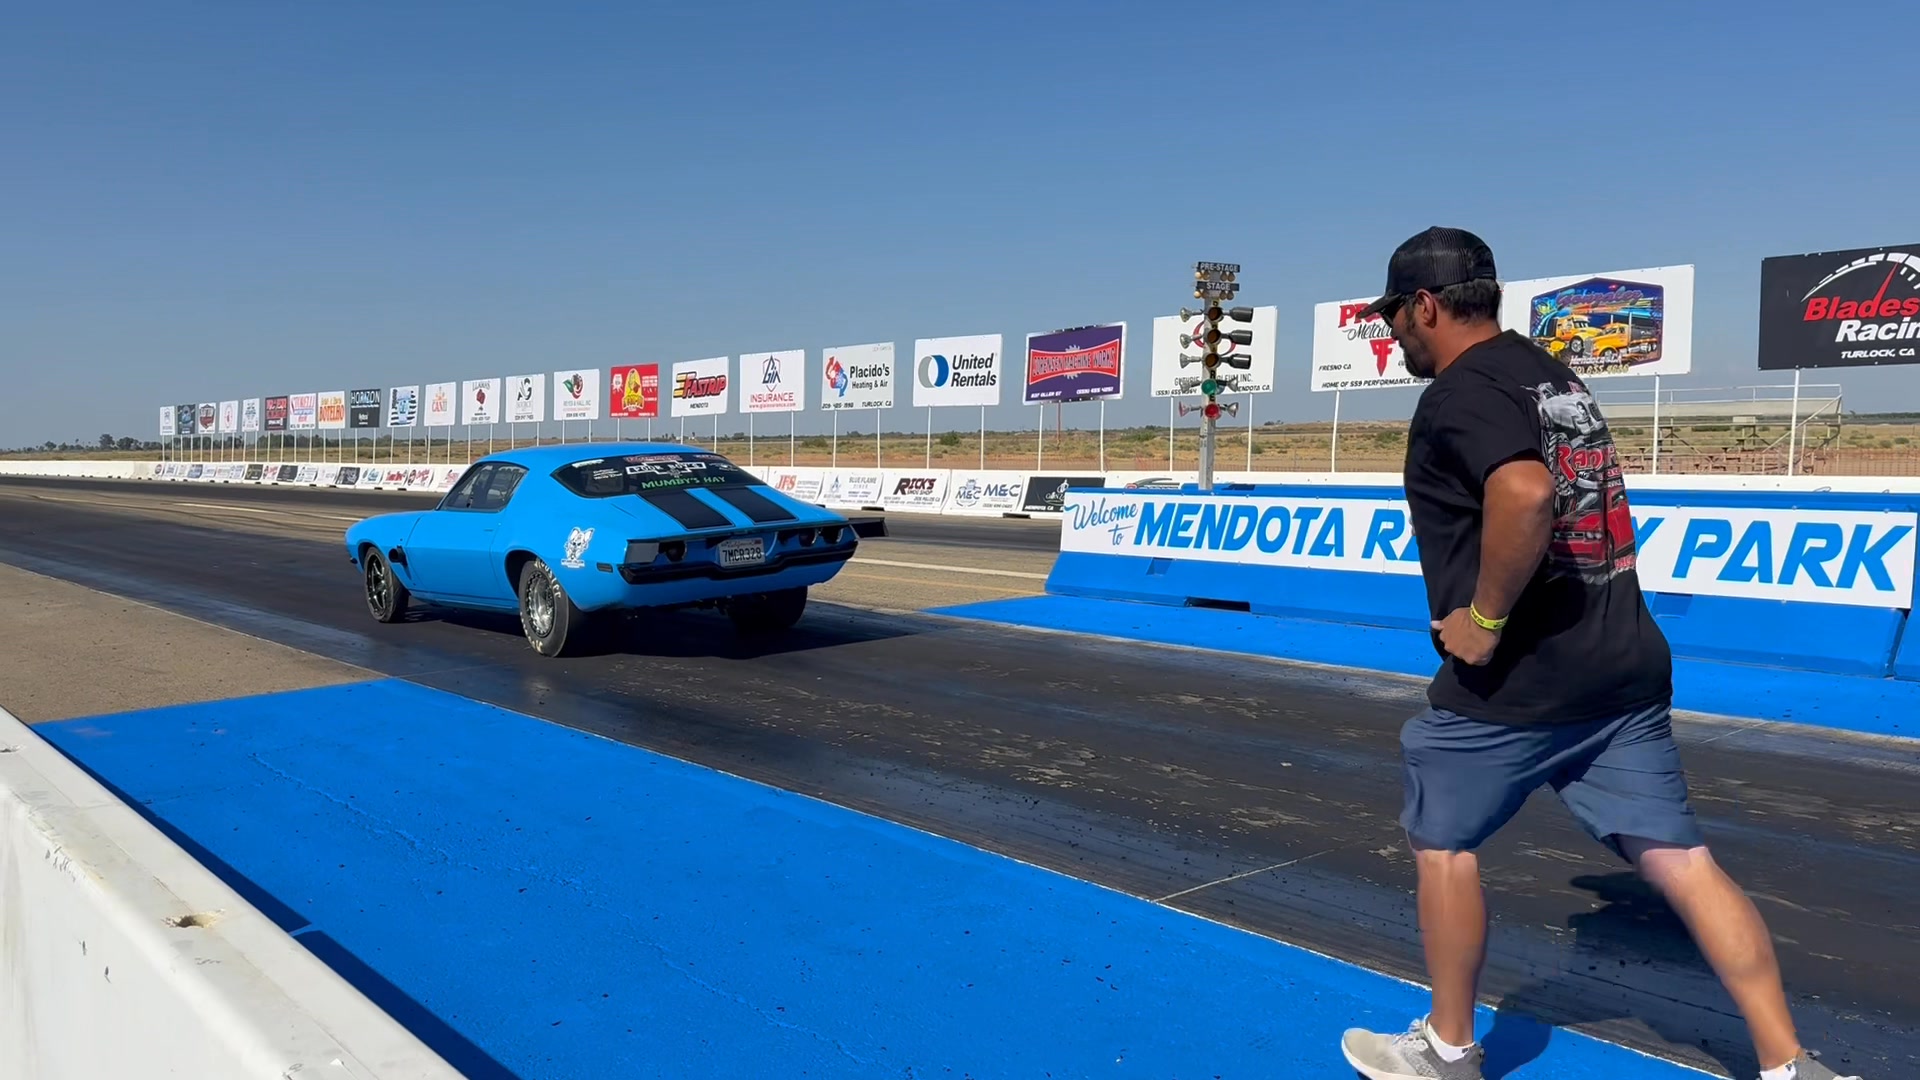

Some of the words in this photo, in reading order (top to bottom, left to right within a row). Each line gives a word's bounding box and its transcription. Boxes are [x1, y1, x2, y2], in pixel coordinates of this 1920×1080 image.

[1200, 262, 1239, 271] PRE-STAGE
[1206, 282, 1231, 290] STAGE
[1803, 296, 1920, 321] Blades
[1898, 348, 1915, 356] CA
[952, 352, 994, 370] United
[849, 363, 890, 379] Placido's
[851, 380, 873, 391] Heating
[879, 380, 888, 388] Air
[950, 371, 997, 388] Rentals
[1363, 378, 1412, 386] PERFORMANCE
[351, 390, 380, 404] HORIZON
[750, 392, 794, 403] INSURANCE
[319, 405, 344, 421] BOTELHO
[641, 477, 700, 489] MUMBY'S
[775, 474, 797, 491] JFS
[893, 478, 937, 495] RICK'S
[955, 490, 981, 500] M&C
[983, 484, 1021, 497] M&C
[1064, 497, 1139, 532] Welcome
[1107, 525, 1134, 547] to
[1133, 502, 1344, 557] MENDOTA
[722, 547, 762, 562] 7MCR328
[1671, 518, 1914, 591] PARK
